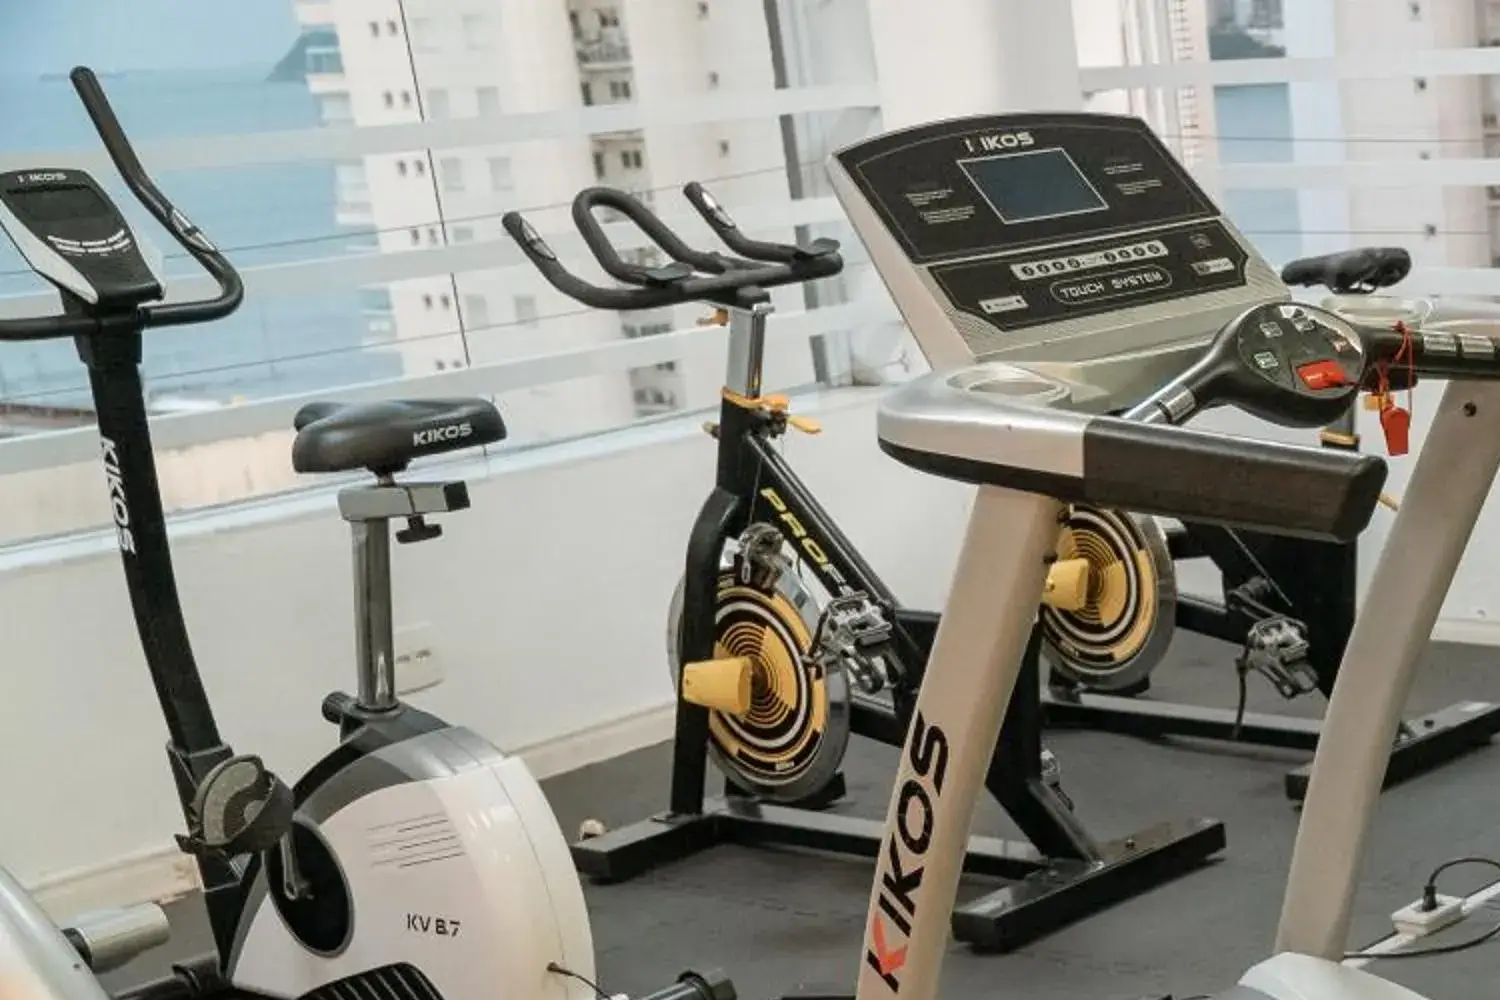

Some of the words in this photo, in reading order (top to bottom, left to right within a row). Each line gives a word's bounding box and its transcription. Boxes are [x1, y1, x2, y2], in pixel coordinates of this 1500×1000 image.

[413, 421, 472, 447] KIKOS
[101, 435, 136, 554] KIKOS
[867, 709, 949, 994] KIKOS
